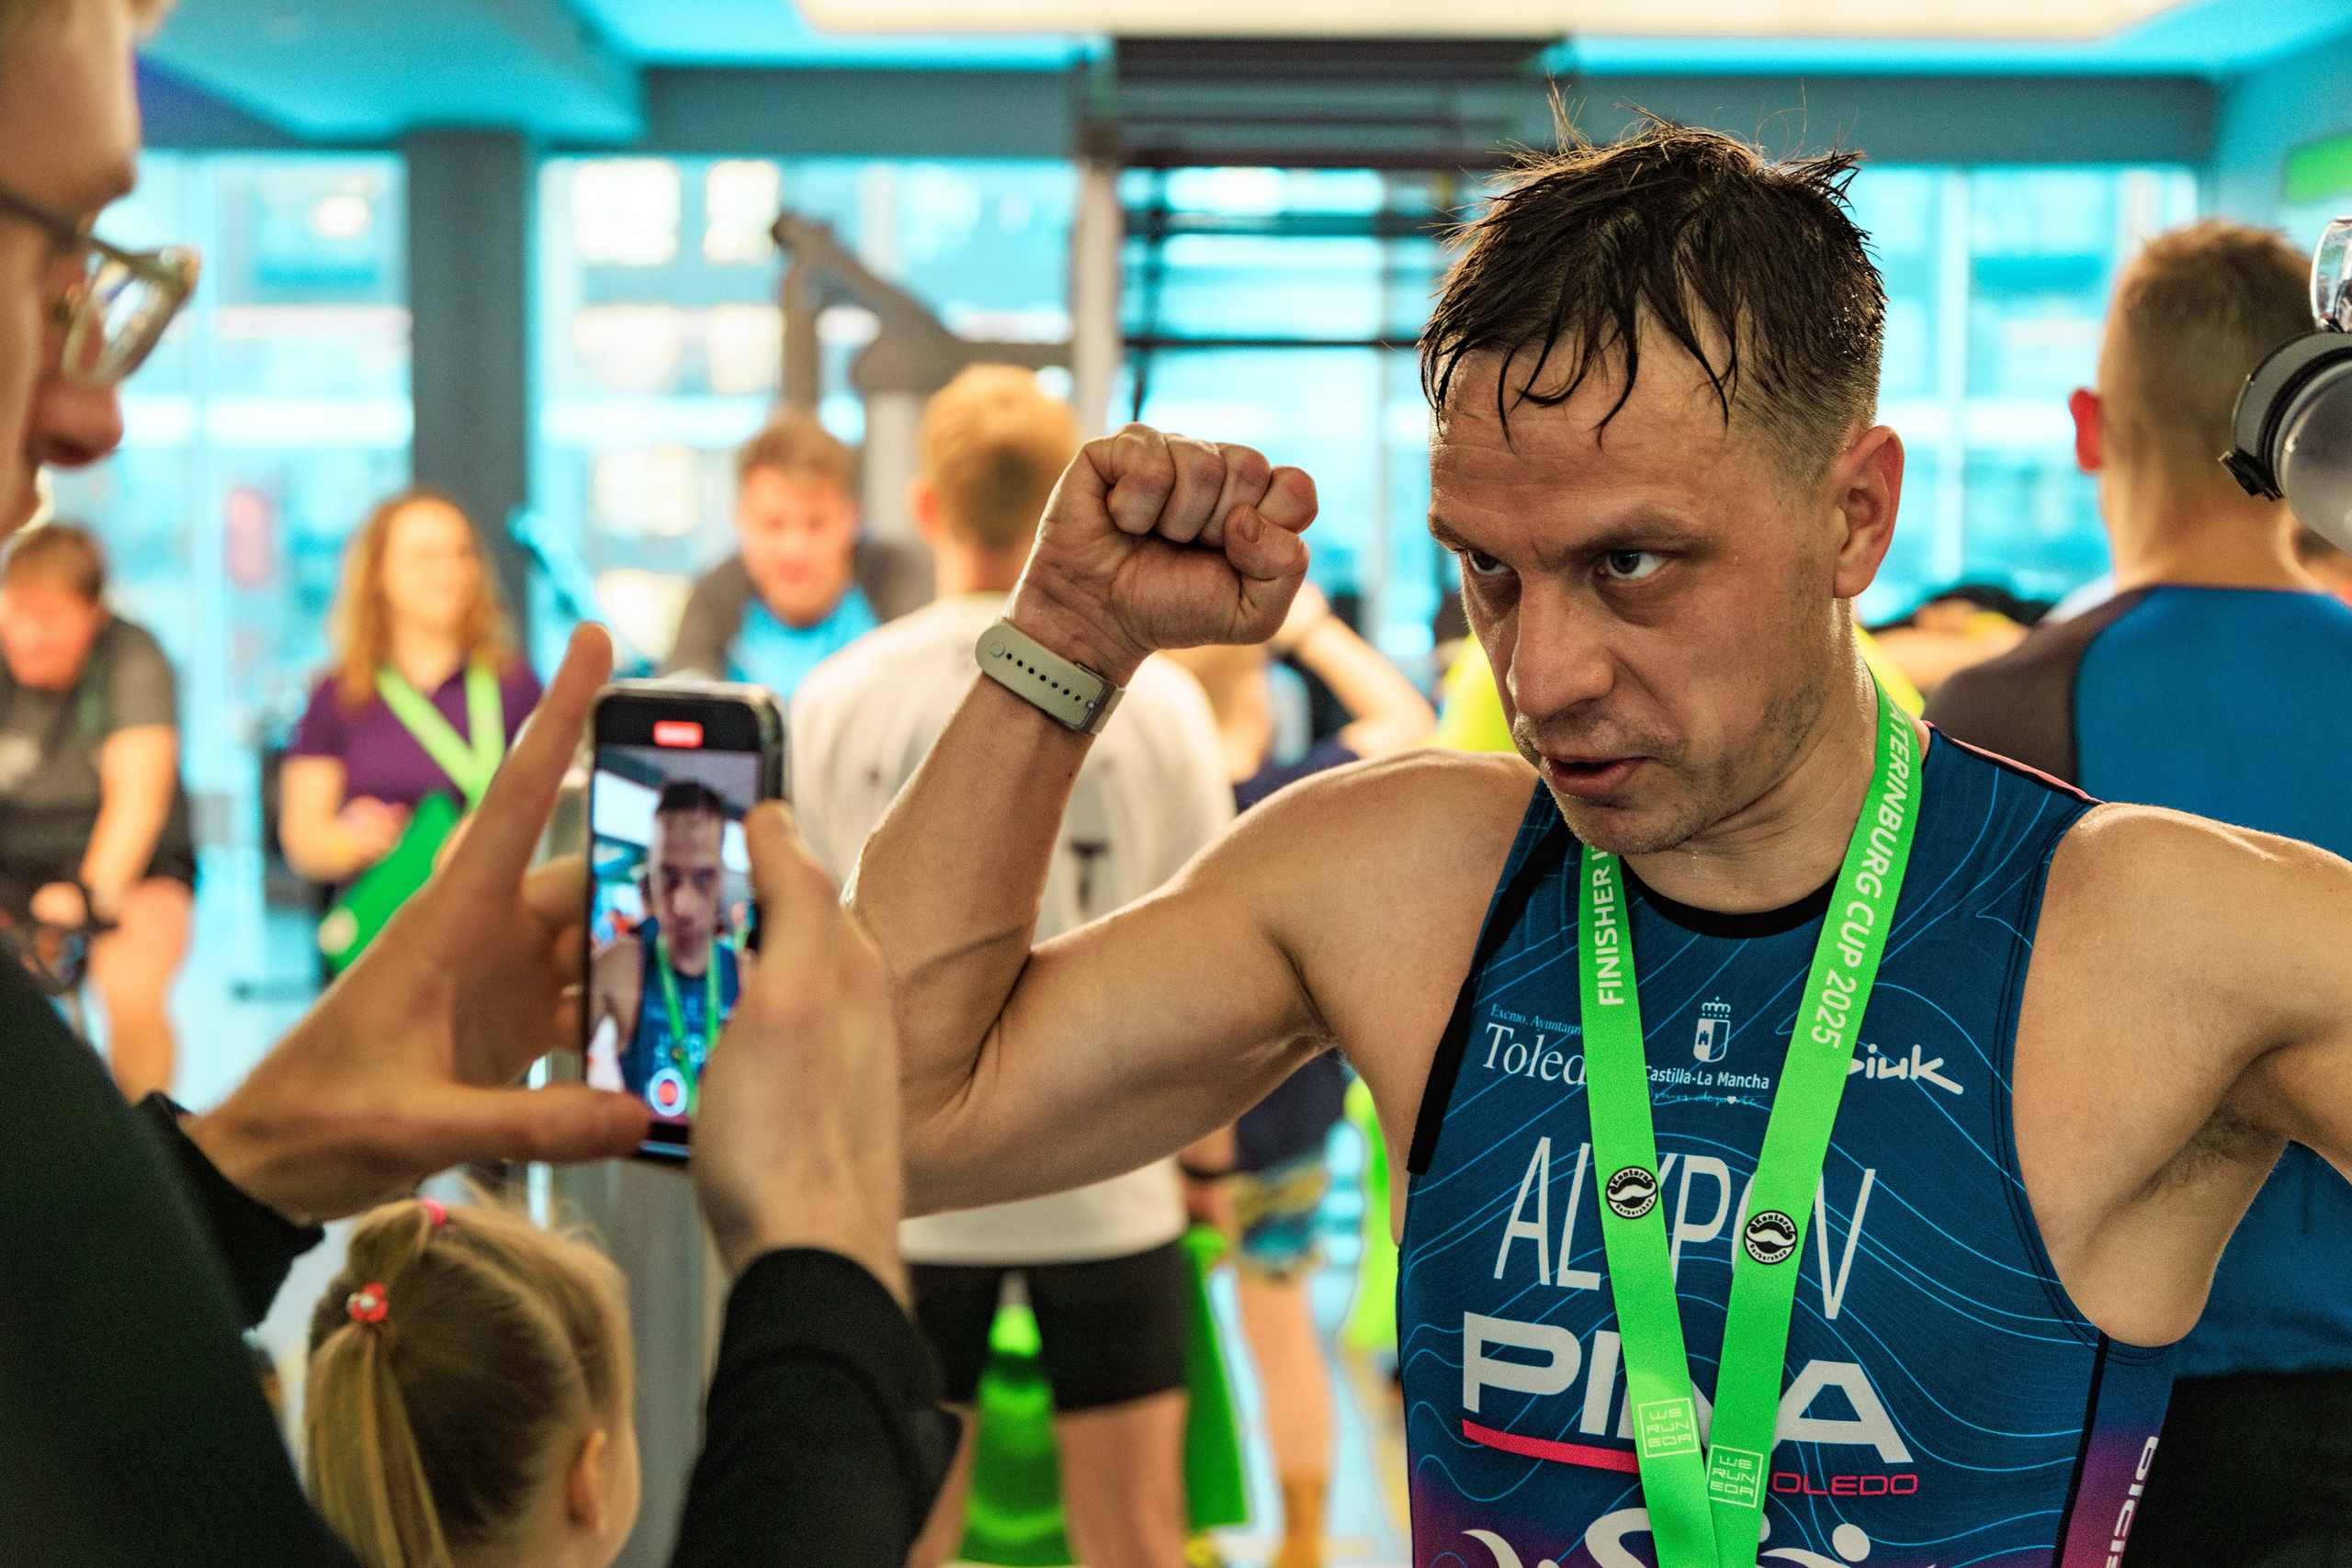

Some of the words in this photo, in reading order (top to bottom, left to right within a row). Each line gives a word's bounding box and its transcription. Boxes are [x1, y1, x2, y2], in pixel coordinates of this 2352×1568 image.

[1855, 695, 1910, 899] ATERINBURG
[1592, 864, 1624, 1005] FINISHER
[1837, 901, 1874, 968] CUP
[1811, 968, 1857, 1049] 2025
[1482, 1022, 1587, 1086] Toled
[1717, 1071, 1770, 1089] Mancha
[1494, 1136, 1876, 1319] ALPV
[1646, 1421, 1690, 1434] RUN
[1649, 1407, 1683, 1419] WE
[1712, 1467, 1756, 1483] RUN
[1719, 1454, 1752, 1470] WE
[1772, 1472, 1918, 1496] OLEDO
